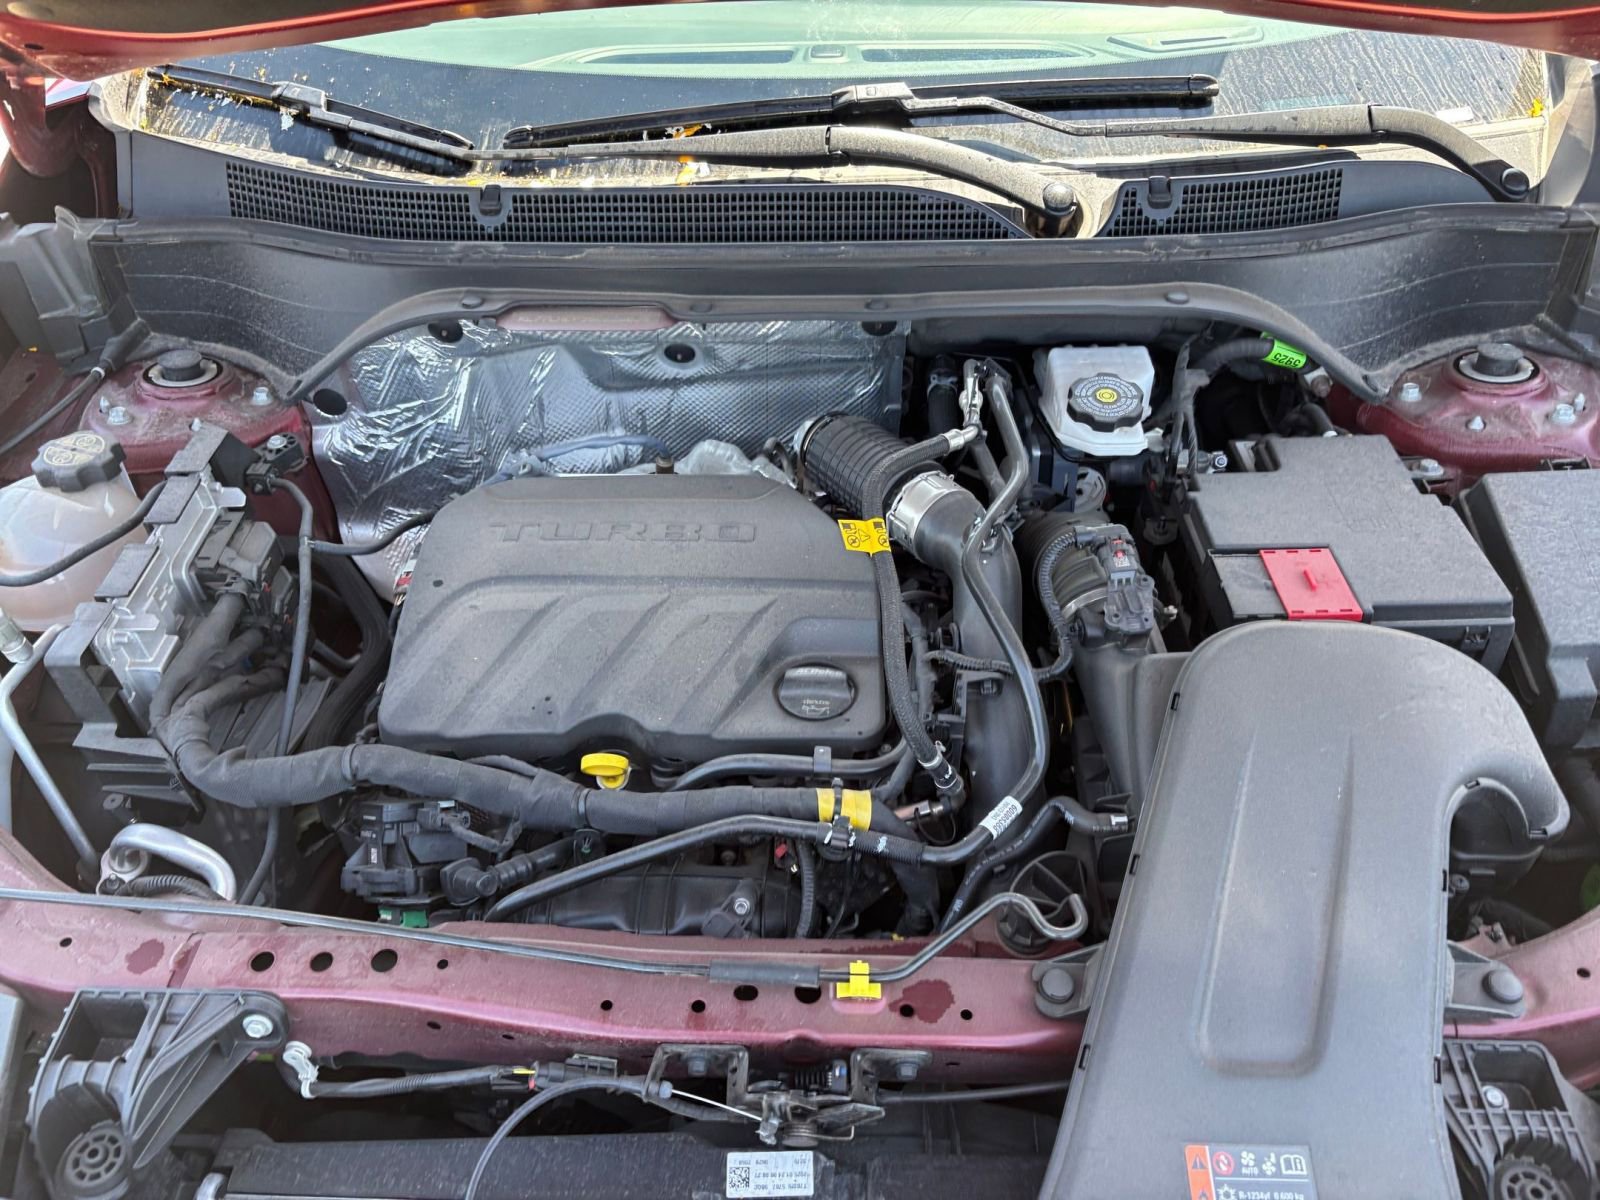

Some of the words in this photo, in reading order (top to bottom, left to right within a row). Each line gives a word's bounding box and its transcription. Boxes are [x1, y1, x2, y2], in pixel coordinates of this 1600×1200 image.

[1271, 352, 1301, 368] 5925
[489, 522, 757, 543] TURBO
[1241, 1166, 1259, 1176] AUTO
